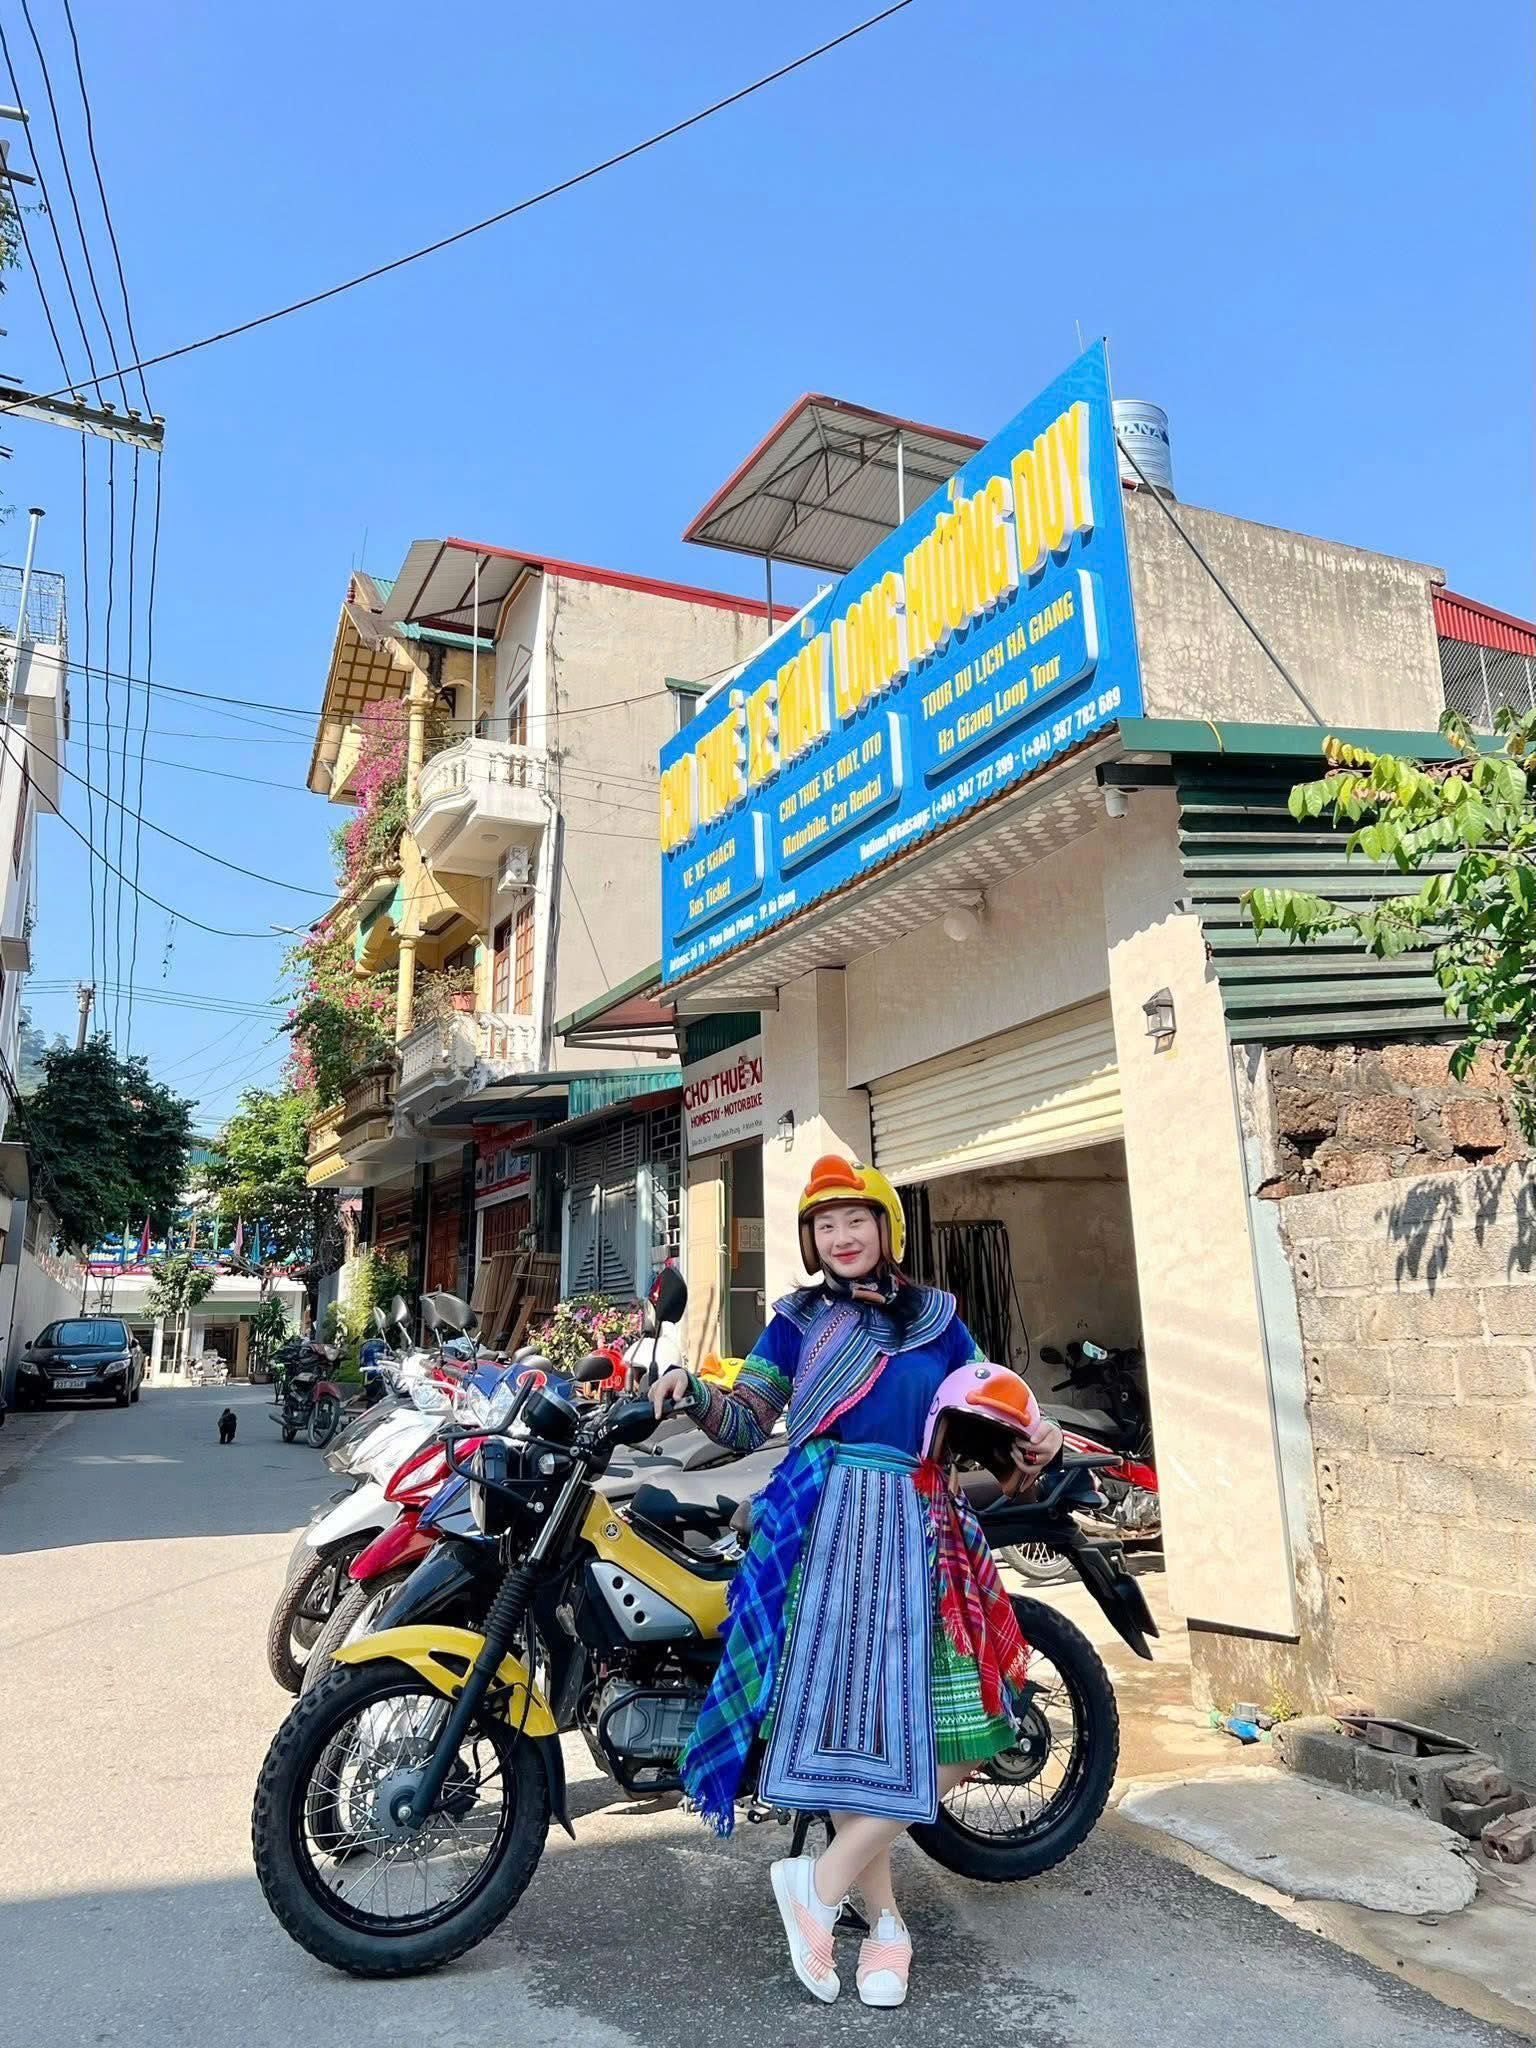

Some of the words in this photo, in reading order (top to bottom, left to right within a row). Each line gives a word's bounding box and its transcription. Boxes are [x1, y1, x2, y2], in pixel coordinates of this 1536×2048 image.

[660, 753, 698, 853] CHO
[695, 689, 747, 825] THUÊ
[746, 677, 780, 788] XE
[776, 617, 831, 763] MÁY
[831, 571, 909, 720] LONG
[1011, 401, 1094, 575] DUY
[922, 680, 953, 720] TOUR
[955, 664, 972, 698] DU
[974, 641, 1005, 686] LỊCH
[1006, 622, 1027, 660] HÀ
[1029, 591, 1074, 645] GIANG
[938, 728, 955, 754] Ha
[957, 702, 993, 742] Giang
[995, 678, 1028, 717] Loop
[1031, 655, 1061, 691] Tour
[932, 789, 956, 820] (+84)
[957, 776, 975, 803] 347
[976, 764, 993, 792] 727
[1022, 730, 1051, 765] (+84)
[1053, 714, 1073, 744] 387
[1074, 700, 1097, 730] 782
[1098, 685, 1121, 716] 689
[779, 794, 797, 823] CHO
[823, 765, 835, 792] XE
[832, 801, 848, 825] Car
[849, 773, 882, 814] Rental
[689, 897, 704, 919] Bus
[706, 876, 731, 908] Ticket
[695, 858, 706, 881] XE
[684, 1079, 710, 1111] CHO
[711, 1056, 747, 1098] THUÊ
[691, 1107, 720, 1128] HOMESTAY
[723, 1092, 763, 1117] MOTORBIKE
